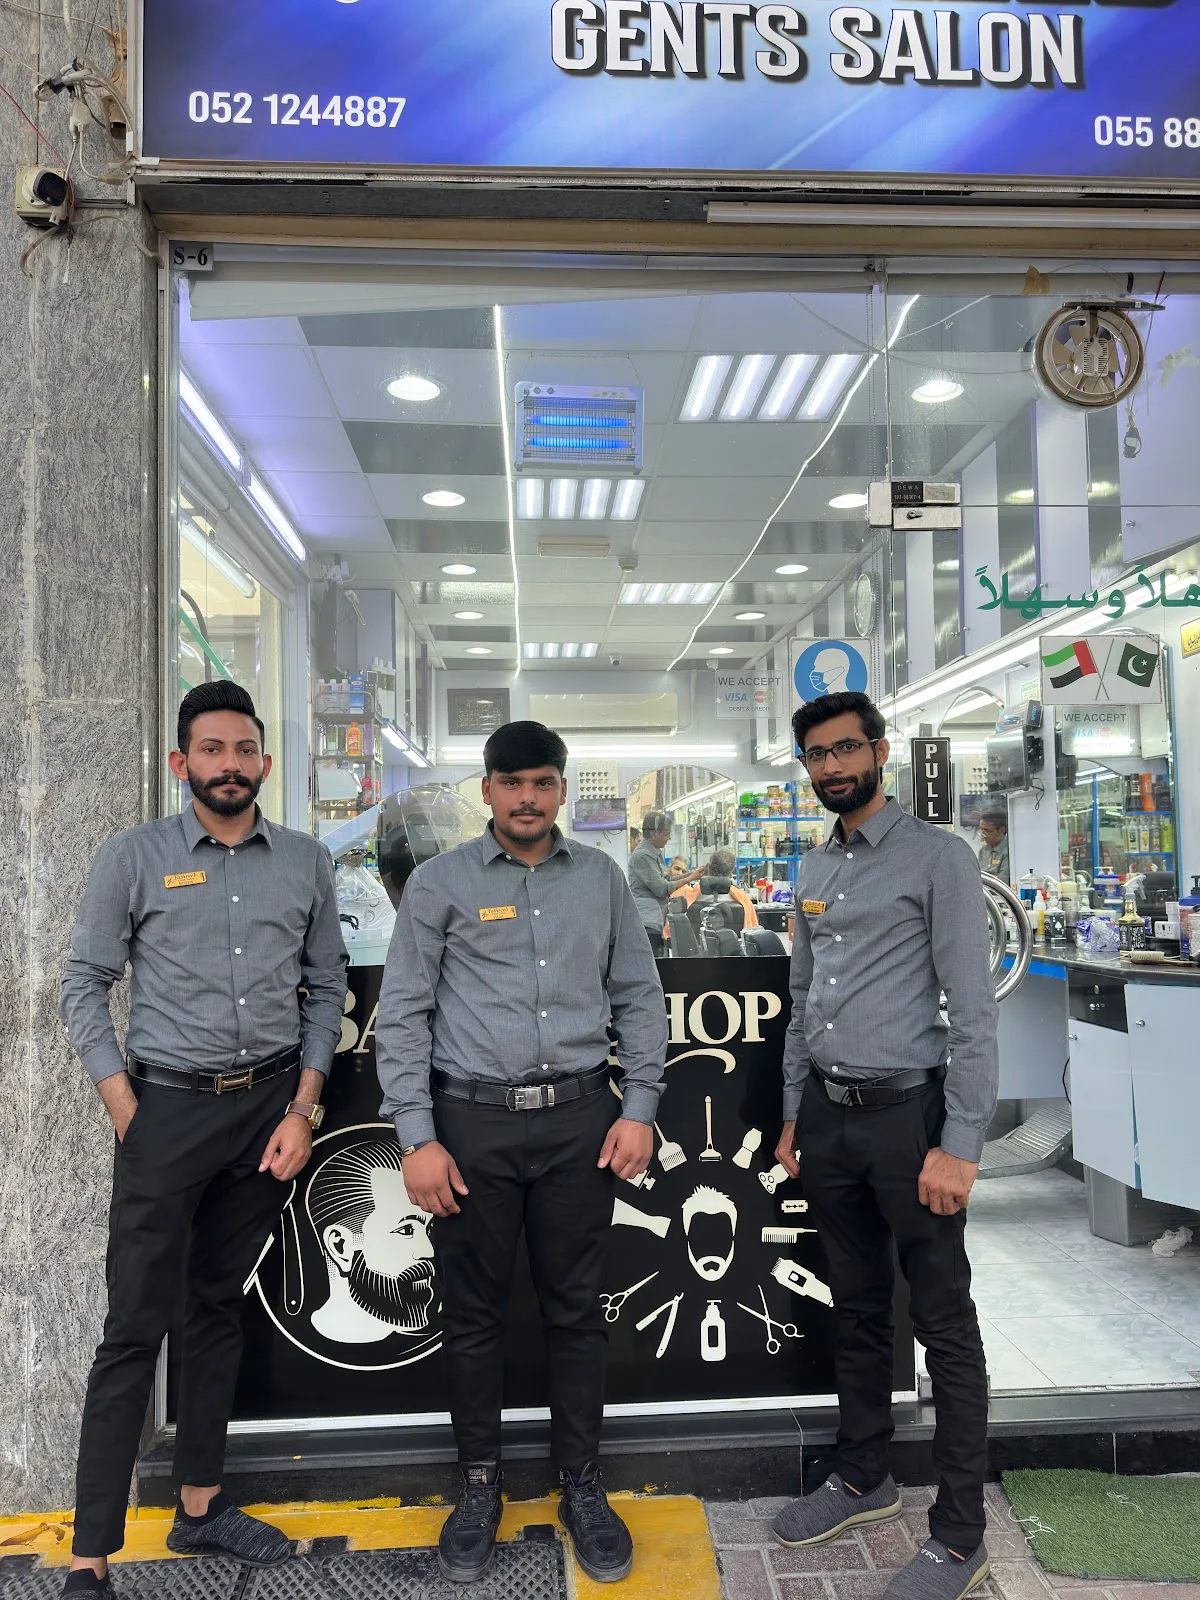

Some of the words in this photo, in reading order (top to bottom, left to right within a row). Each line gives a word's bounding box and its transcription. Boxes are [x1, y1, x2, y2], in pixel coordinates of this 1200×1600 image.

[551, 0, 802, 78] GENTS
[830, 8, 1079, 84] SALON
[188, 90, 253, 124] 052
[262, 93, 407, 128] 1244887
[1094, 115, 1154, 147] 055
[173, 246, 208, 266] S-6
[717, 677, 735, 686] WE
[737, 677, 781, 686] ACCEPT
[725, 692, 748, 702] VISA
[1063, 713, 1081, 722] WE
[1083, 713, 1127, 722] ACCEPT
[925, 743, 939, 818] PULL
